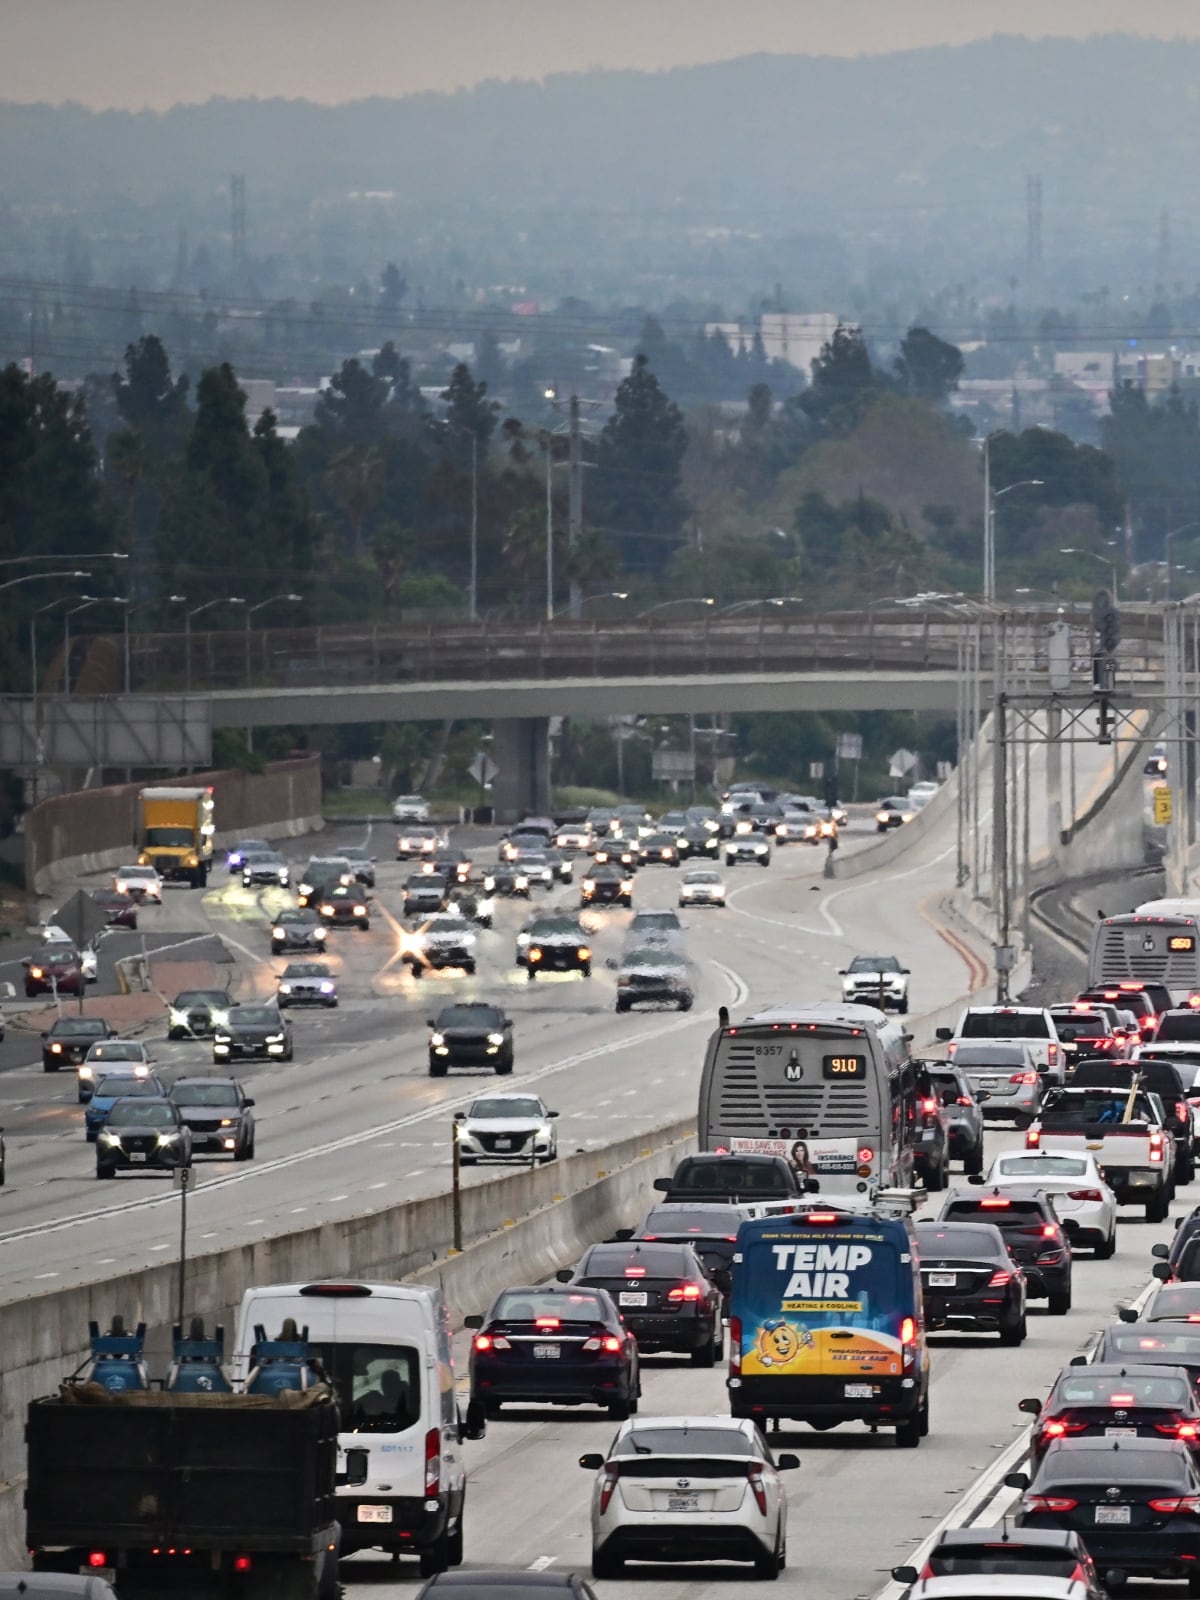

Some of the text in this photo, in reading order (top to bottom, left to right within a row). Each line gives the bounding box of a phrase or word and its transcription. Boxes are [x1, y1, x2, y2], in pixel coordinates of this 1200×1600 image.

[756, 1046, 783, 1055] 8357
[832, 1059, 857, 1072] 910
[787, 1066, 801, 1079] M
[181, 1169, 189, 1183] 8
[772, 1245, 872, 1271] TEMP
[783, 1273, 850, 1298] AIR
